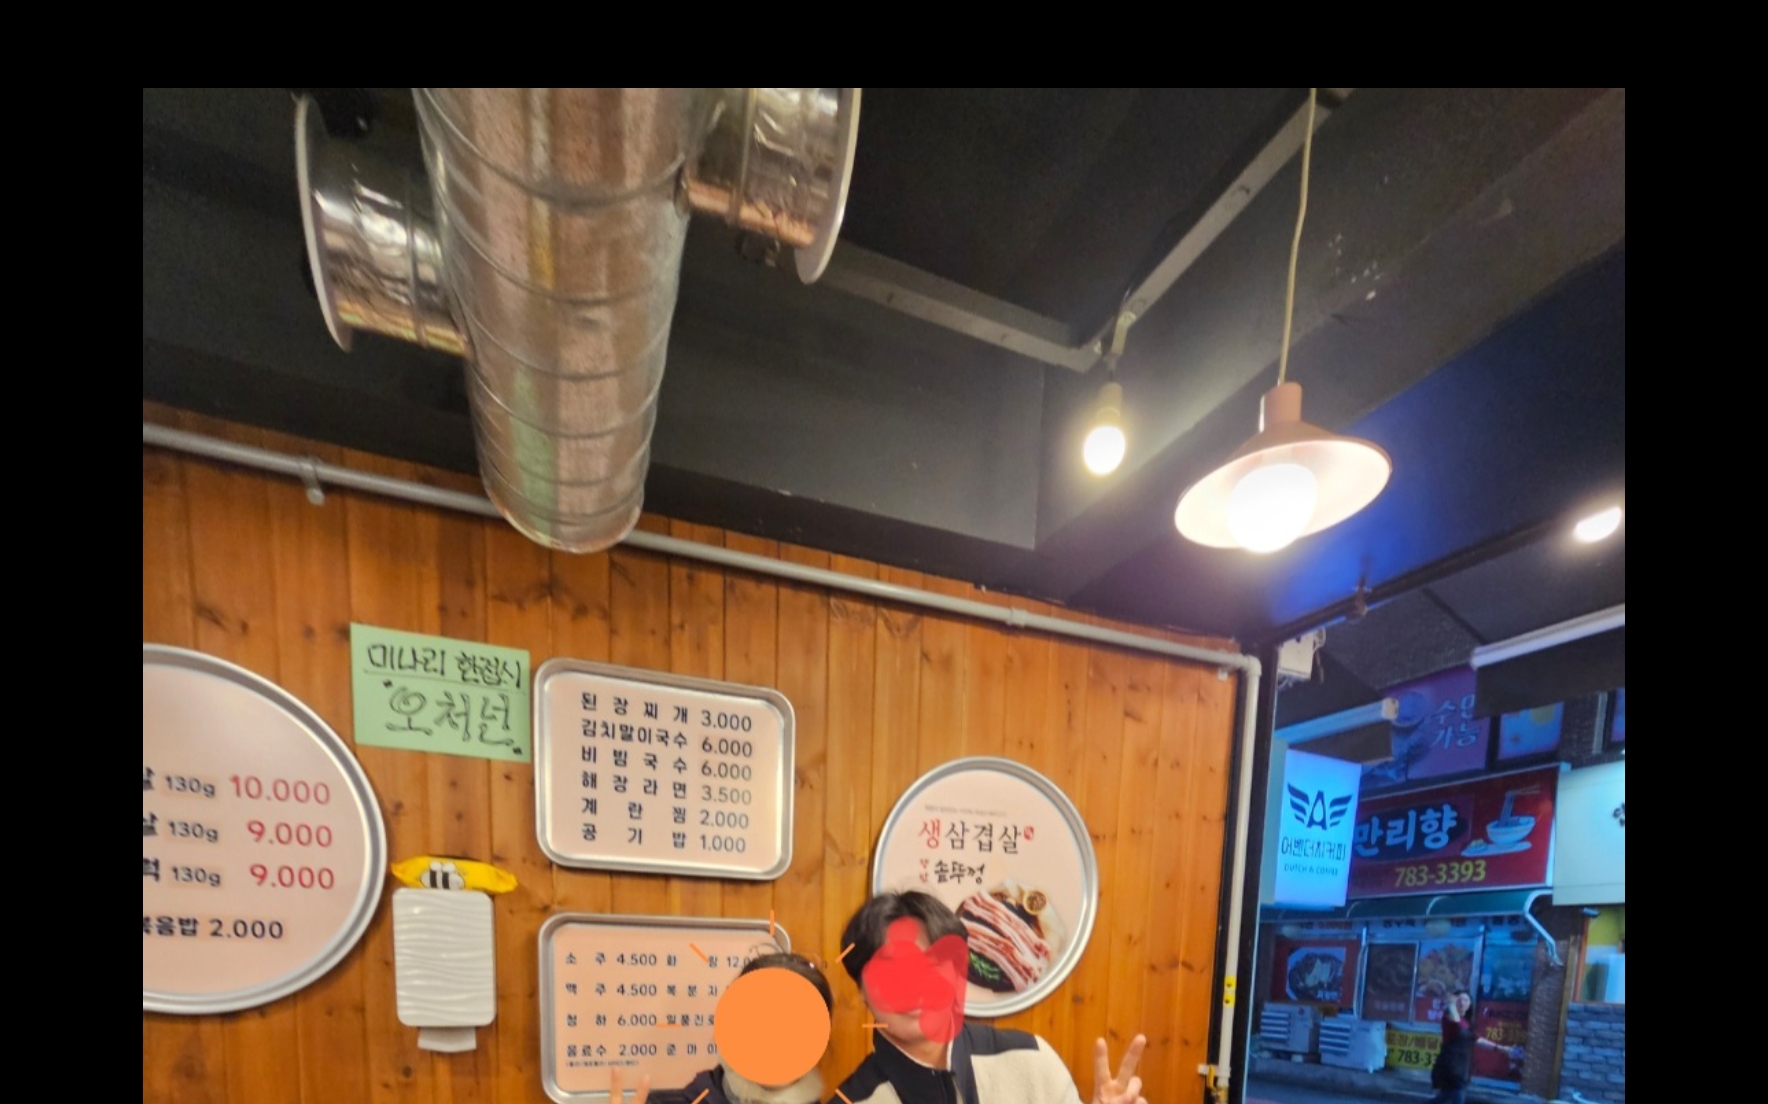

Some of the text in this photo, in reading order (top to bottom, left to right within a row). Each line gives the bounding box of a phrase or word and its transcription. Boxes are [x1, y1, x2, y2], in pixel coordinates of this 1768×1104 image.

[367, 644, 522, 690] 미나리 한접시
[581, 692, 752, 733] 된장찌개 3.000
[581, 719, 753, 758] 김치말이국수 6.000
[581, 746, 752, 782] 비빔국수 6.000
[164, 774, 216, 799] 130g
[229, 774, 331, 805] 10.000
[581, 771, 752, 806] 해장라면 3.500
[581, 797, 749, 830] 계란찜 2.000
[168, 820, 219, 844] 130g
[246, 819, 333, 849] 9.000
[581, 823, 746, 854] 공기밥 1.000
[918, 819, 1022, 855] 생삼겹살
[1354, 803, 1458, 859] 만리향
[171, 866, 221, 888] 130g
[249, 863, 335, 890] 9.000
[934, 859, 985, 885] 솥뚜껑
[1394, 860, 1487, 888] 783-3393
[209, 918, 284, 940] 2.000
[565, 952, 606, 966] 소주
[616, 953, 658, 967] 4.500
[726, 956, 752, 969] 12.0
[565, 983, 606, 996] 맥주
[616, 983, 658, 997] 4.500
[567, 1013, 607, 1027] 청하
[617, 1013, 658, 1027] 6.000
[567, 1043, 607, 1058] 음료수
[618, 1043, 658, 1057] 2.000
[1397, 1049, 1438, 1067] 783-3
